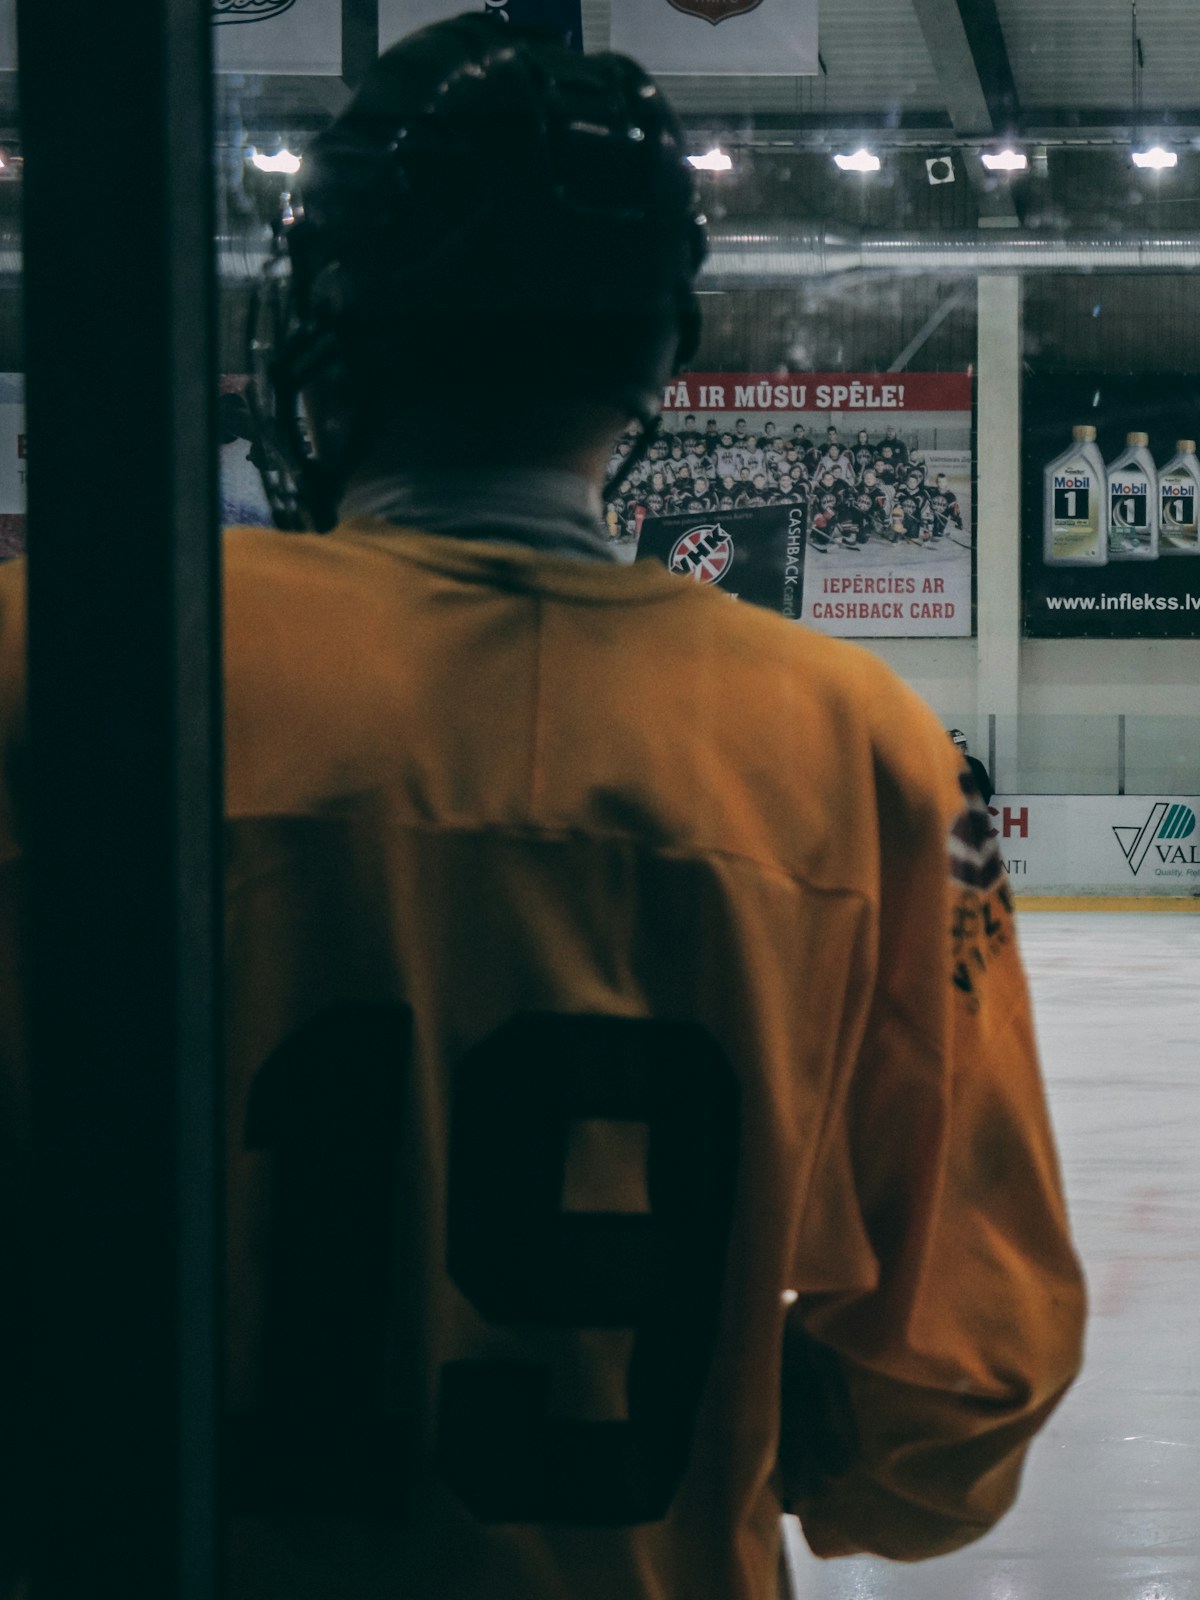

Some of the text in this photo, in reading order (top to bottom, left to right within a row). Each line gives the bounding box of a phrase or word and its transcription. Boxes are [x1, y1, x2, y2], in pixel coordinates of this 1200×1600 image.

[698, 385, 726, 408] IR
[734, 380, 807, 409] MŪSU
[816, 380, 905, 409] SPĒLE!
[1054, 477, 1090, 488] Mobil
[1111, 483, 1147, 494] Mobil
[1162, 486, 1195, 496] Mobil
[1064, 491, 1077, 517] 1
[1124, 498, 1136, 524] 1
[1173, 499, 1184, 522] 1
[782, 508, 803, 617] CASHBACK card
[922, 577, 945, 594] AR
[812, 602, 956, 619] CASHBACK CARD
[226, 998, 741, 1527] 19
